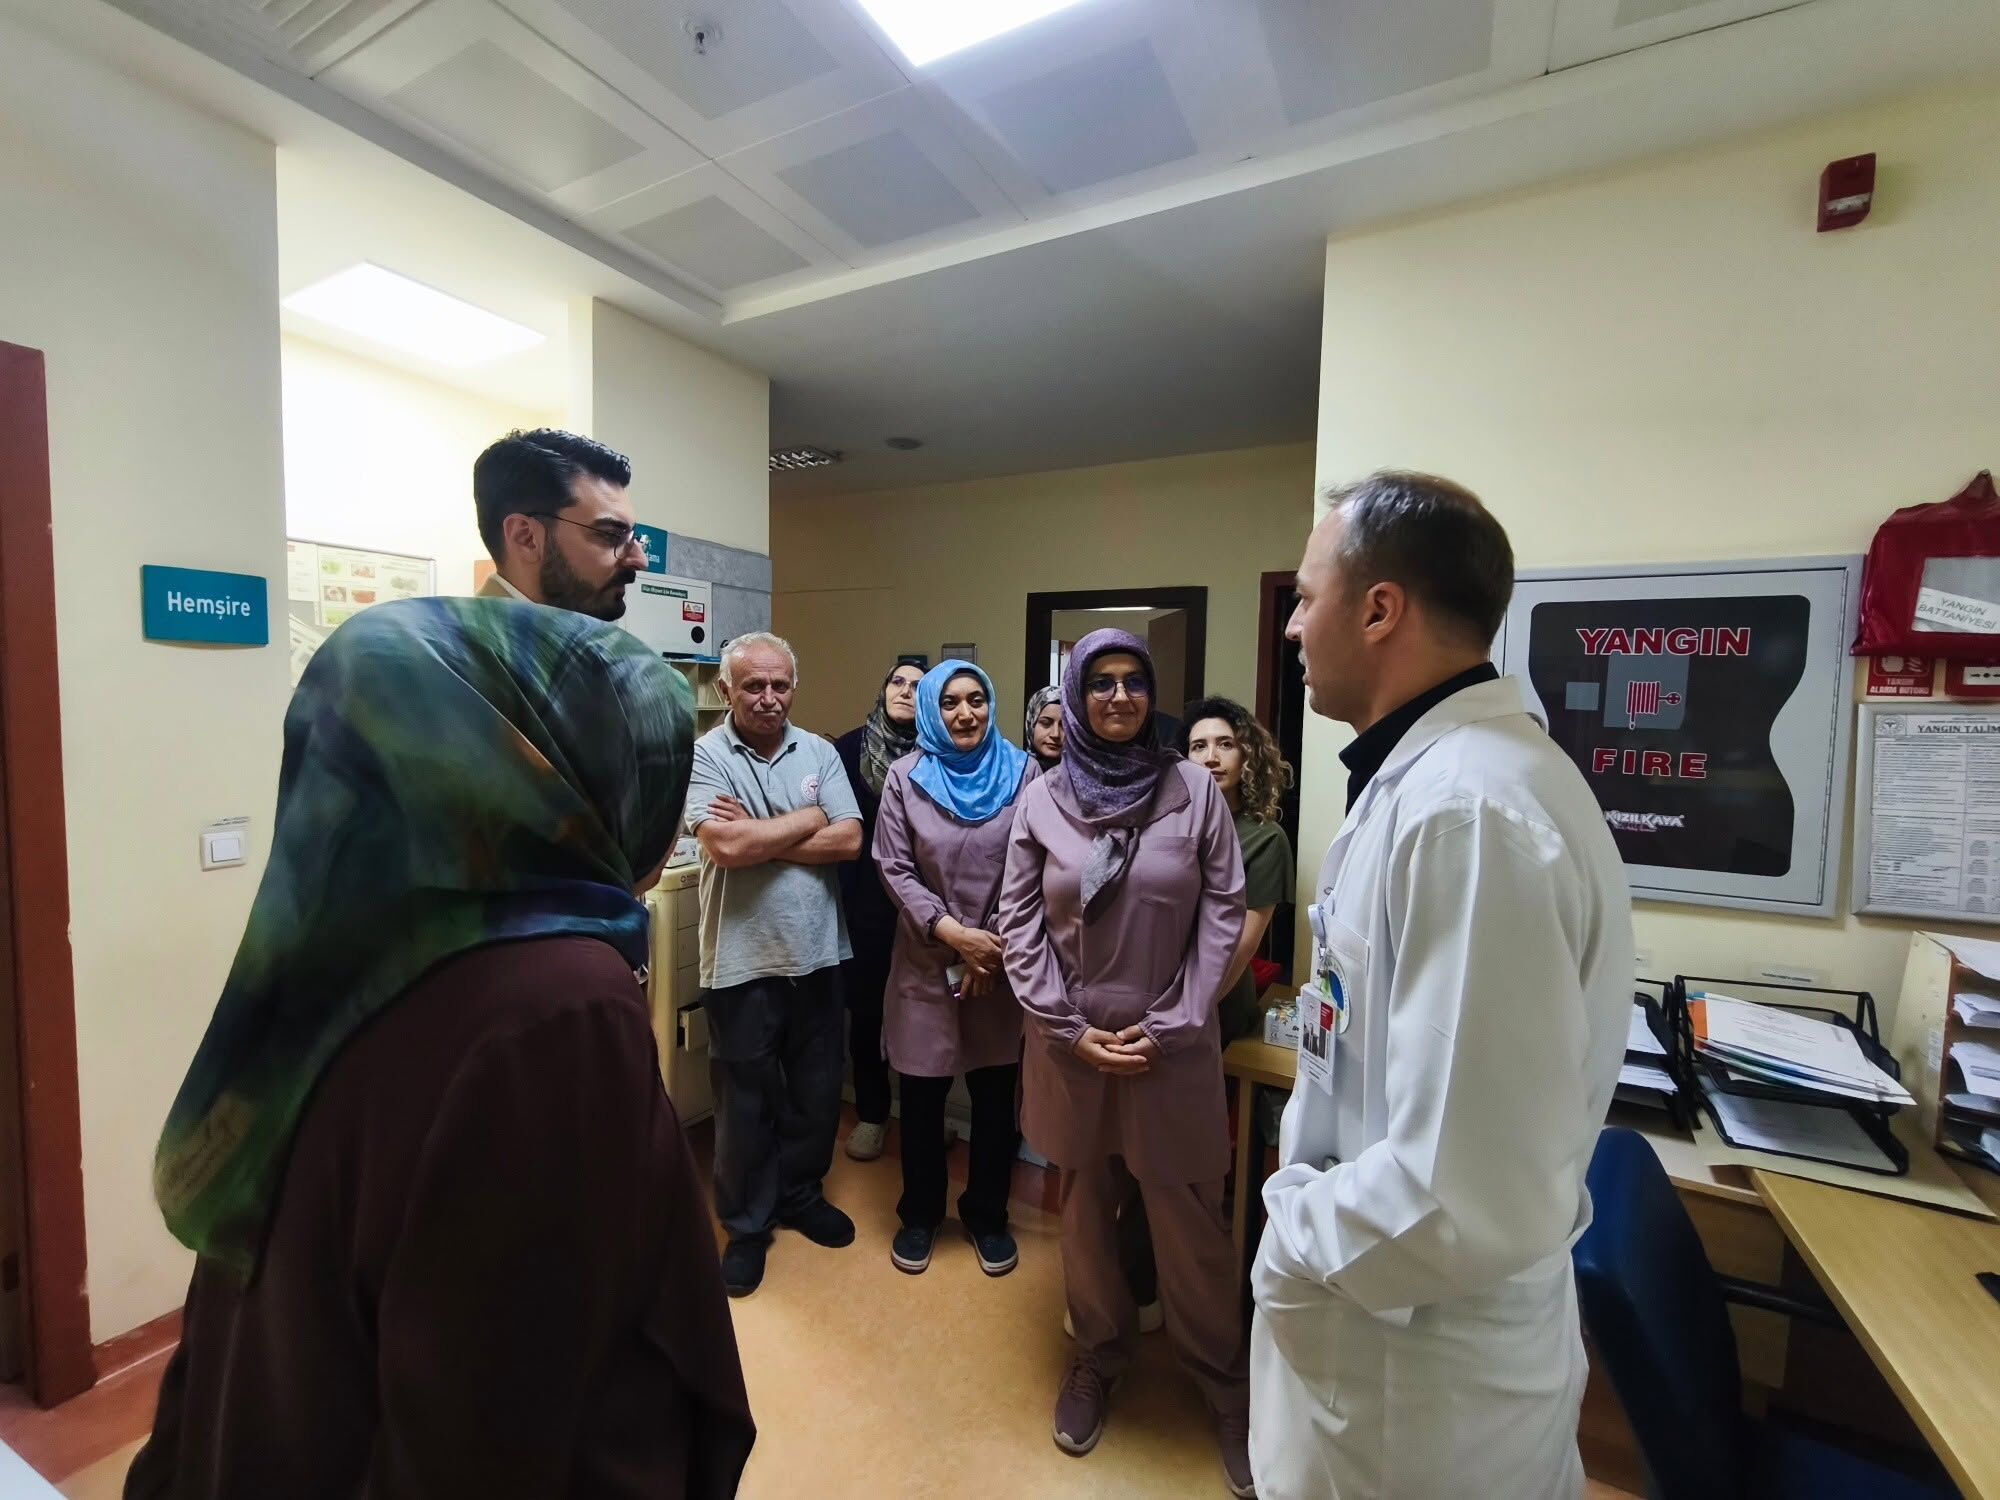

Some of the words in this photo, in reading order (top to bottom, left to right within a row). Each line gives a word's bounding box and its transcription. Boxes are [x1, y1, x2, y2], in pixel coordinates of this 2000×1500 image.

[167, 590, 251, 620] Hemşire
[1941, 598, 1988, 616] YANGIN
[1575, 627, 1751, 656] YANGIN
[1917, 725, 1961, 734] YANGIN
[1592, 747, 1708, 779] FIRE
